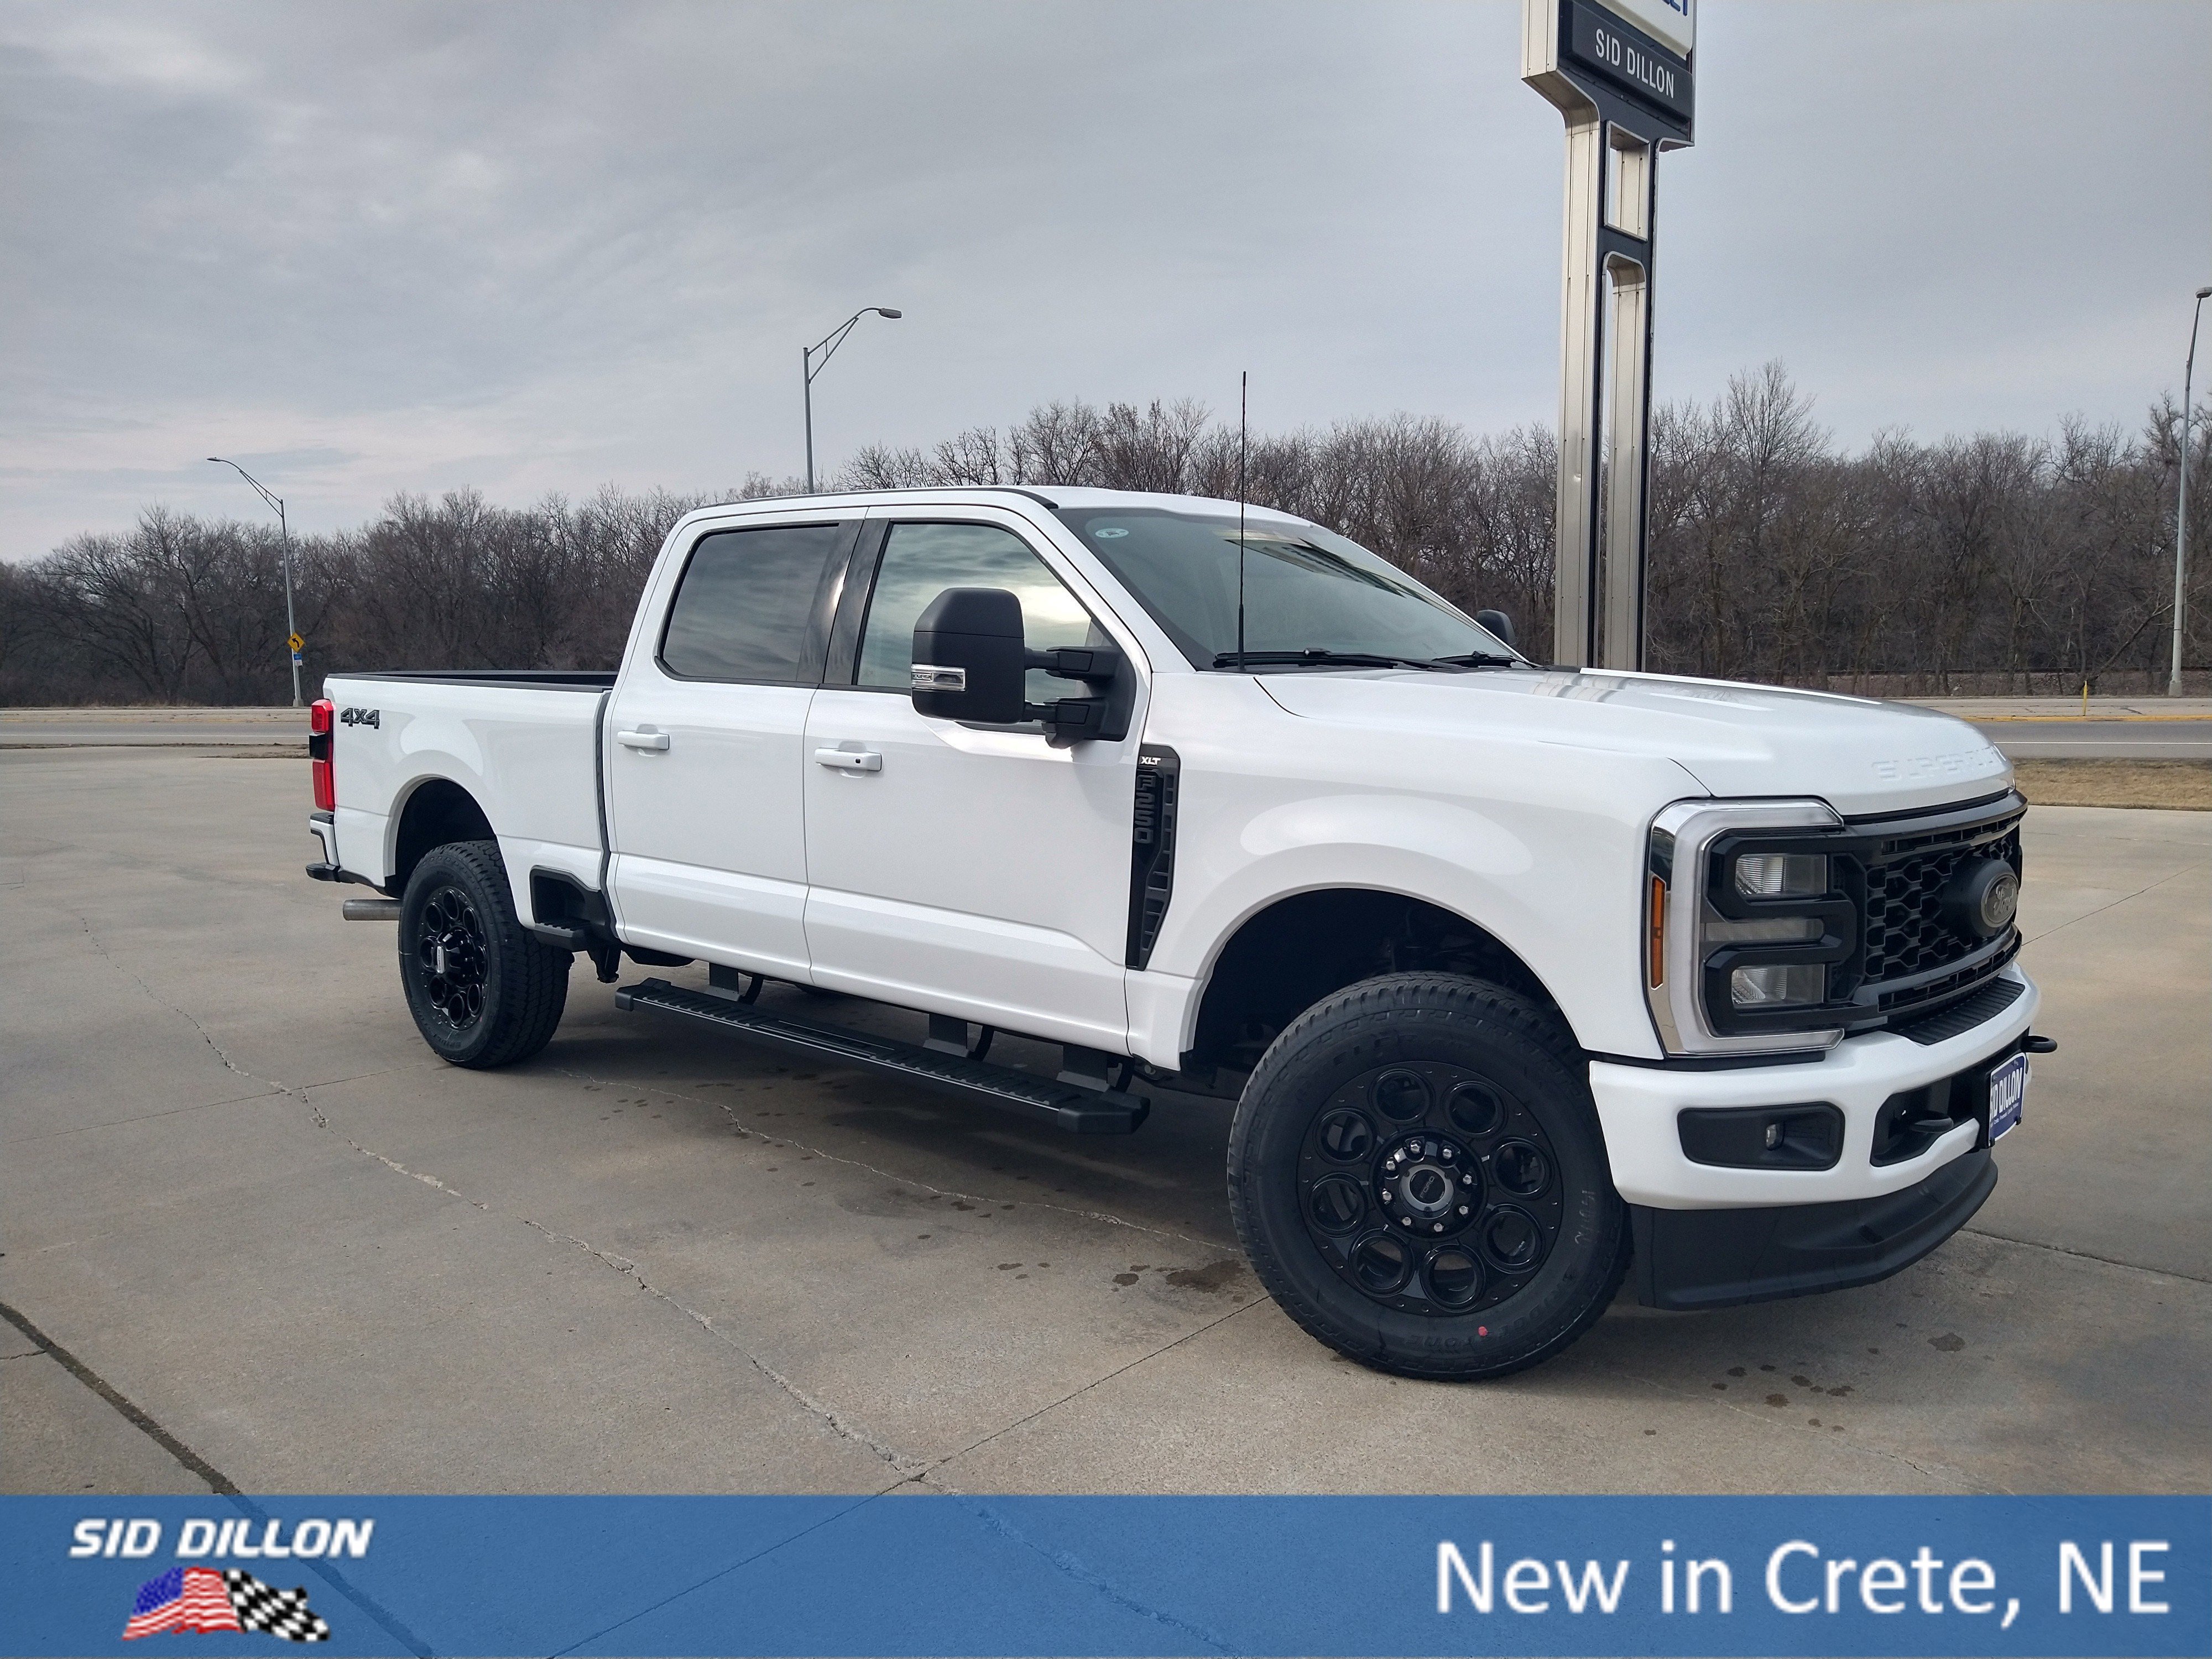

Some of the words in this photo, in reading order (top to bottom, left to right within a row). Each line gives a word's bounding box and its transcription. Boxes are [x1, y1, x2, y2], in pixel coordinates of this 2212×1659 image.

[1595, 28, 1620, 67] SID
[1626, 46, 1674, 98] DILLON
[1140, 756, 1161, 765] XLT
[1993, 883, 2015, 916] Ford
[1999, 1067, 2023, 1114] DILLON
[1419, 1175, 1436, 1199] FORD
